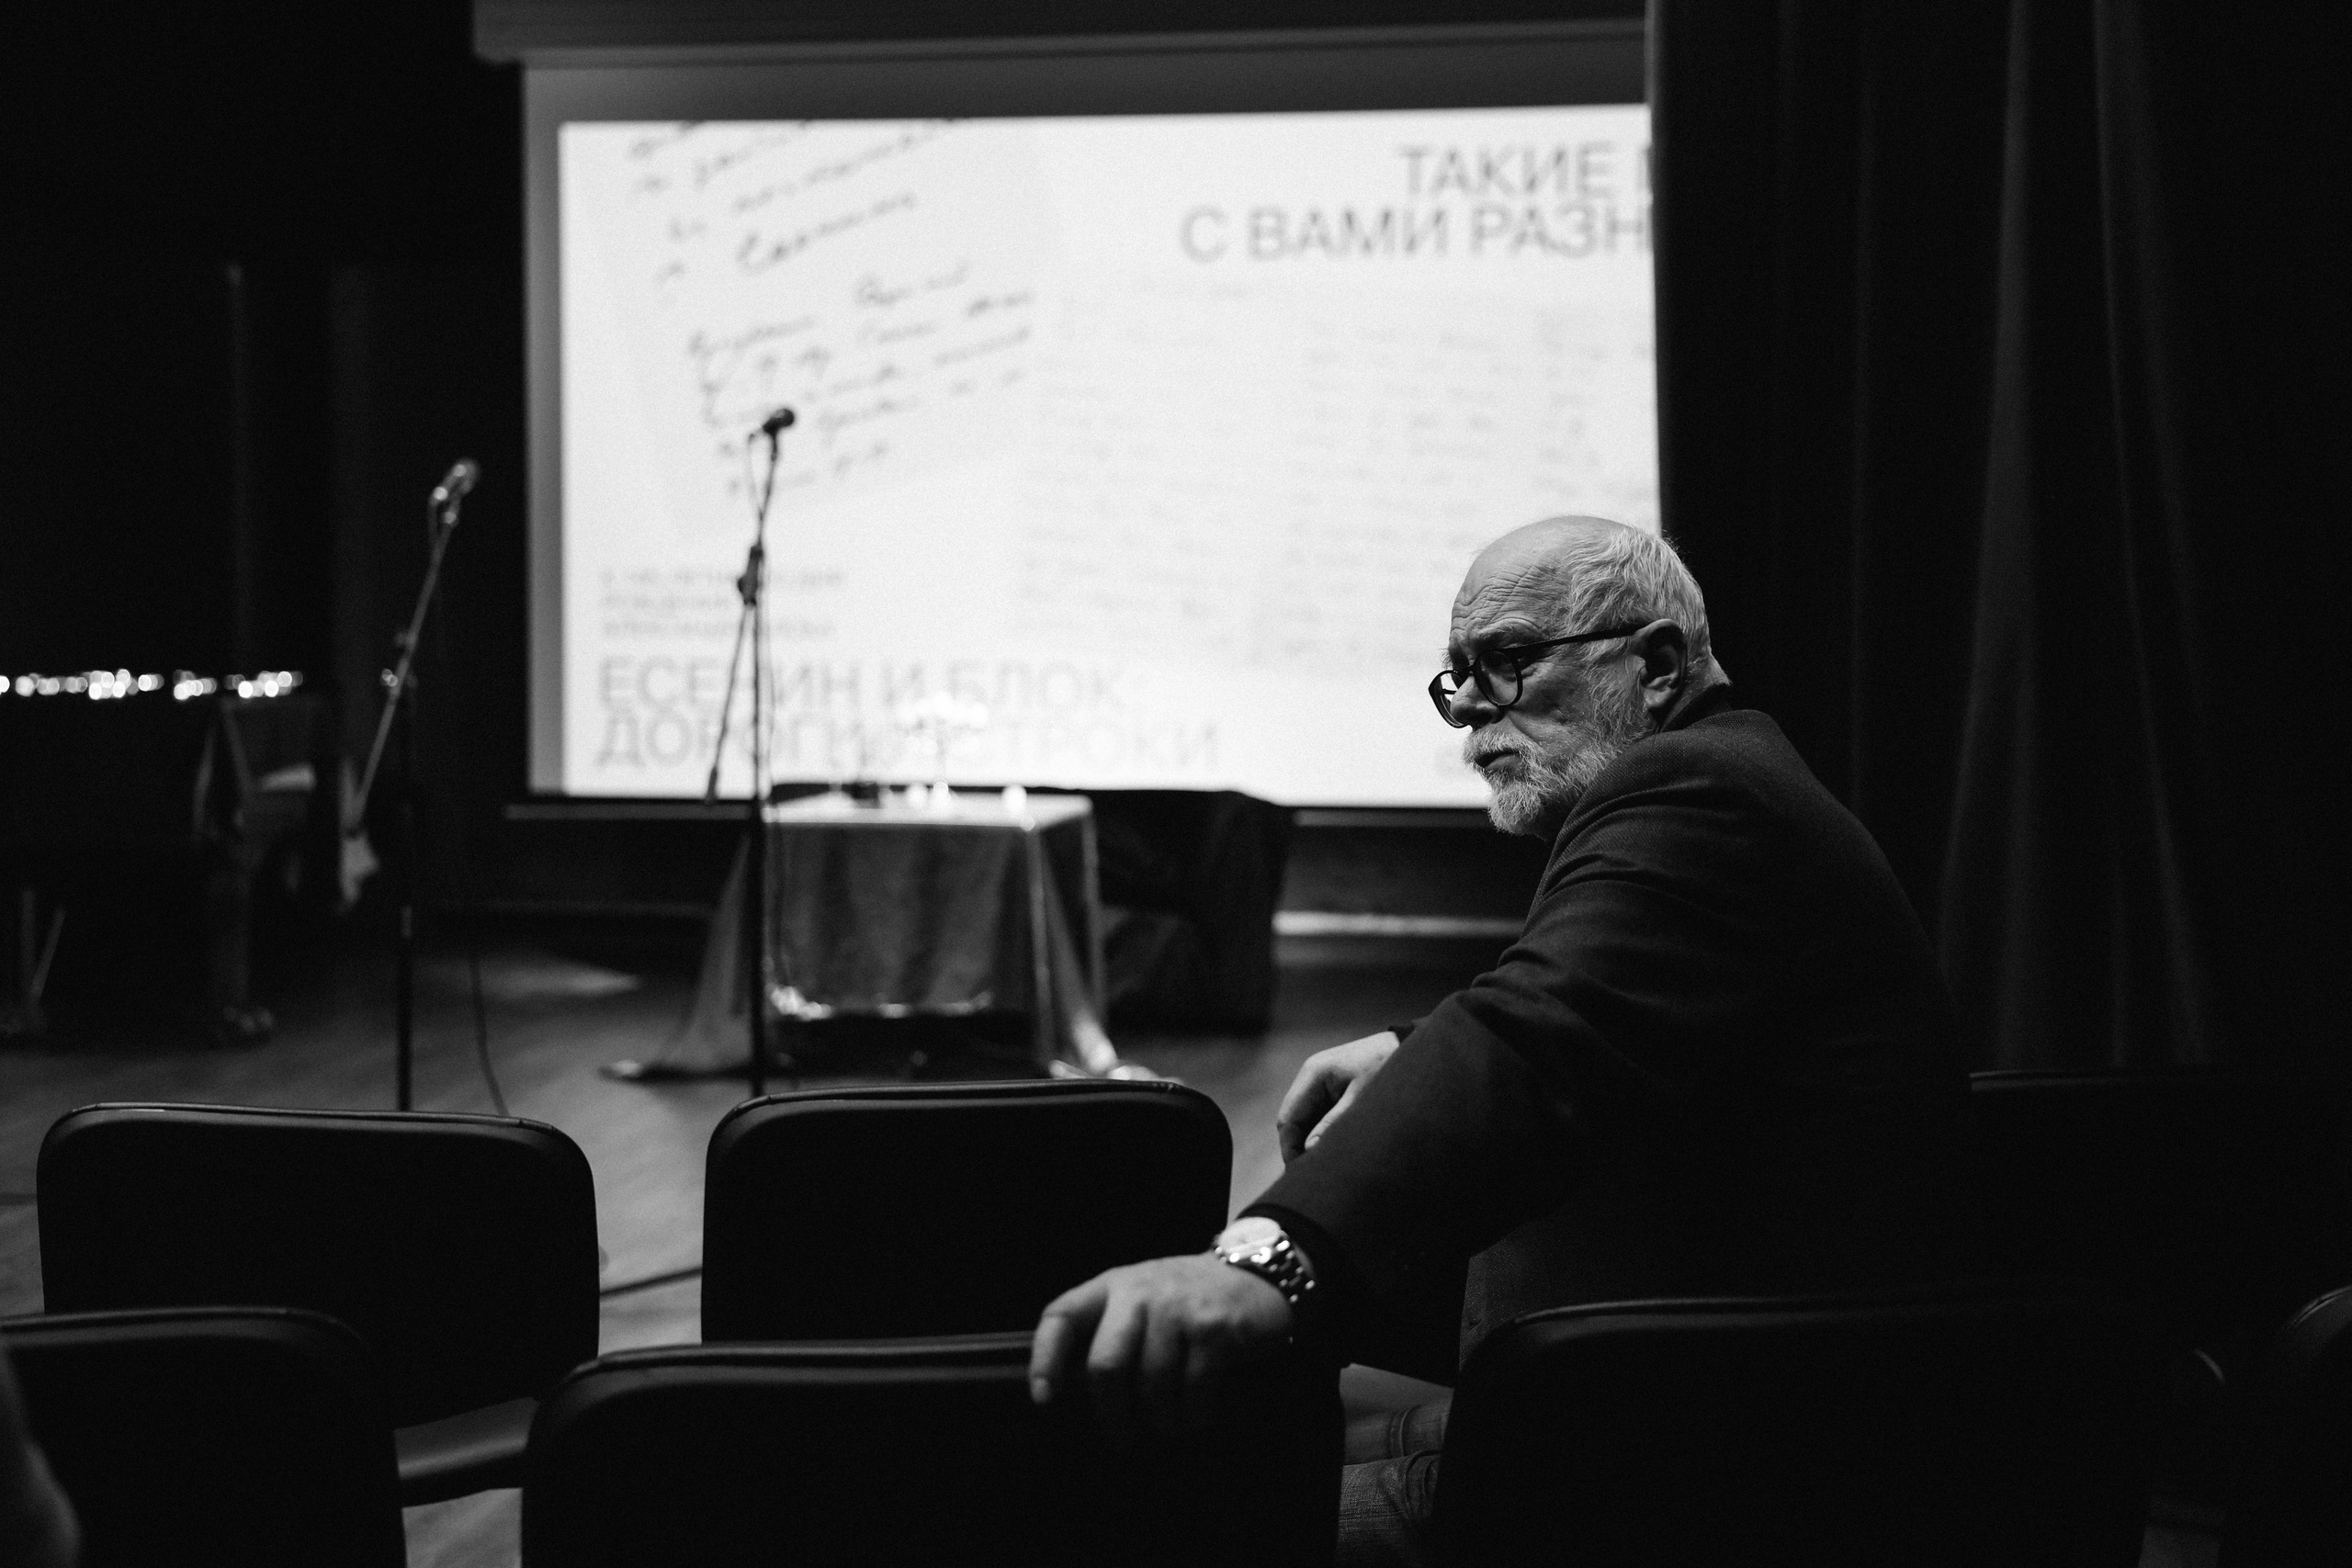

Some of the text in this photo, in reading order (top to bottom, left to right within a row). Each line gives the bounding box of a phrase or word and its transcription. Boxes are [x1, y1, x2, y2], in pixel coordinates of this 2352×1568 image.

[1396, 141, 1615, 199] ТАКИЕ
[1182, 204, 1227, 263] С
[1247, 204, 1449, 260] ВАМИ
[599, 655, 862, 709] ЕСЕИН
